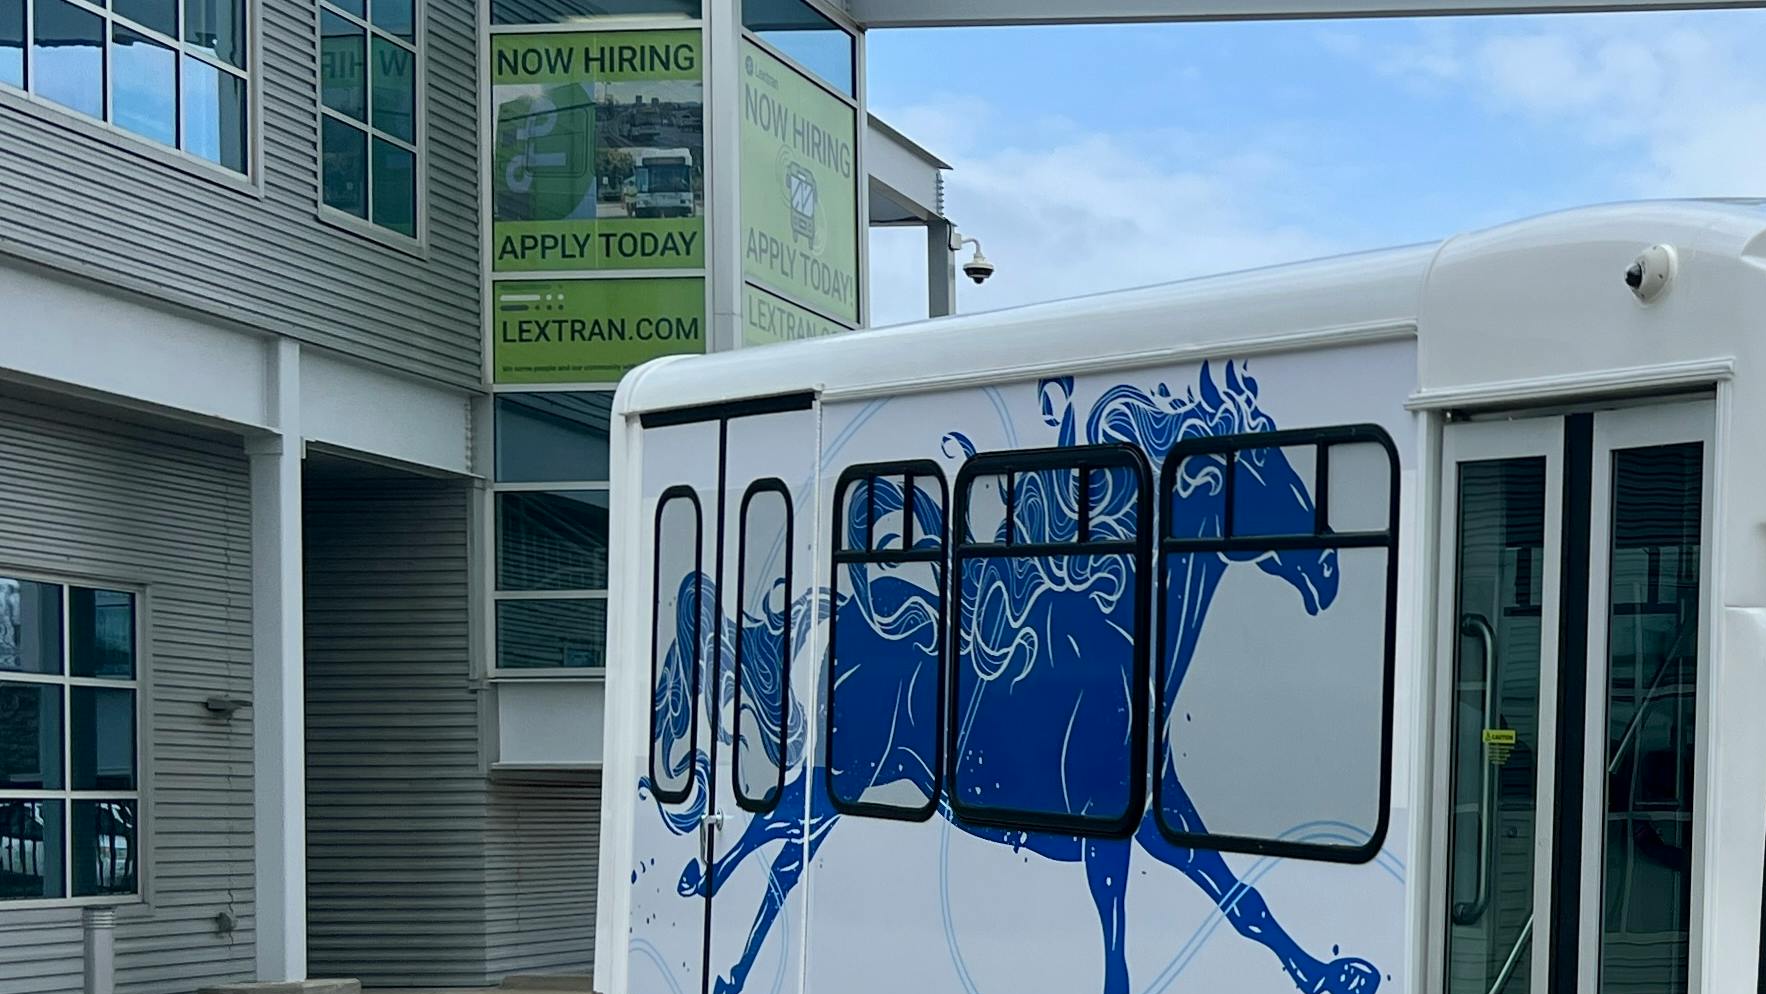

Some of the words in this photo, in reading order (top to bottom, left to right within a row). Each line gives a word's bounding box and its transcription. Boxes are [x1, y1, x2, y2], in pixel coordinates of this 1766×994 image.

[497, 47, 574, 76] NOW
[584, 44, 695, 73] HIRING
[745, 82, 788, 143] NOW
[793, 112, 851, 179] HIRING
[498, 233, 591, 260] APPLY
[598, 231, 698, 258] TODAY
[746, 226, 797, 280] APPLY
[799, 252, 854, 308] TODAY!
[502, 317, 699, 343] LEXTRAN.COM
